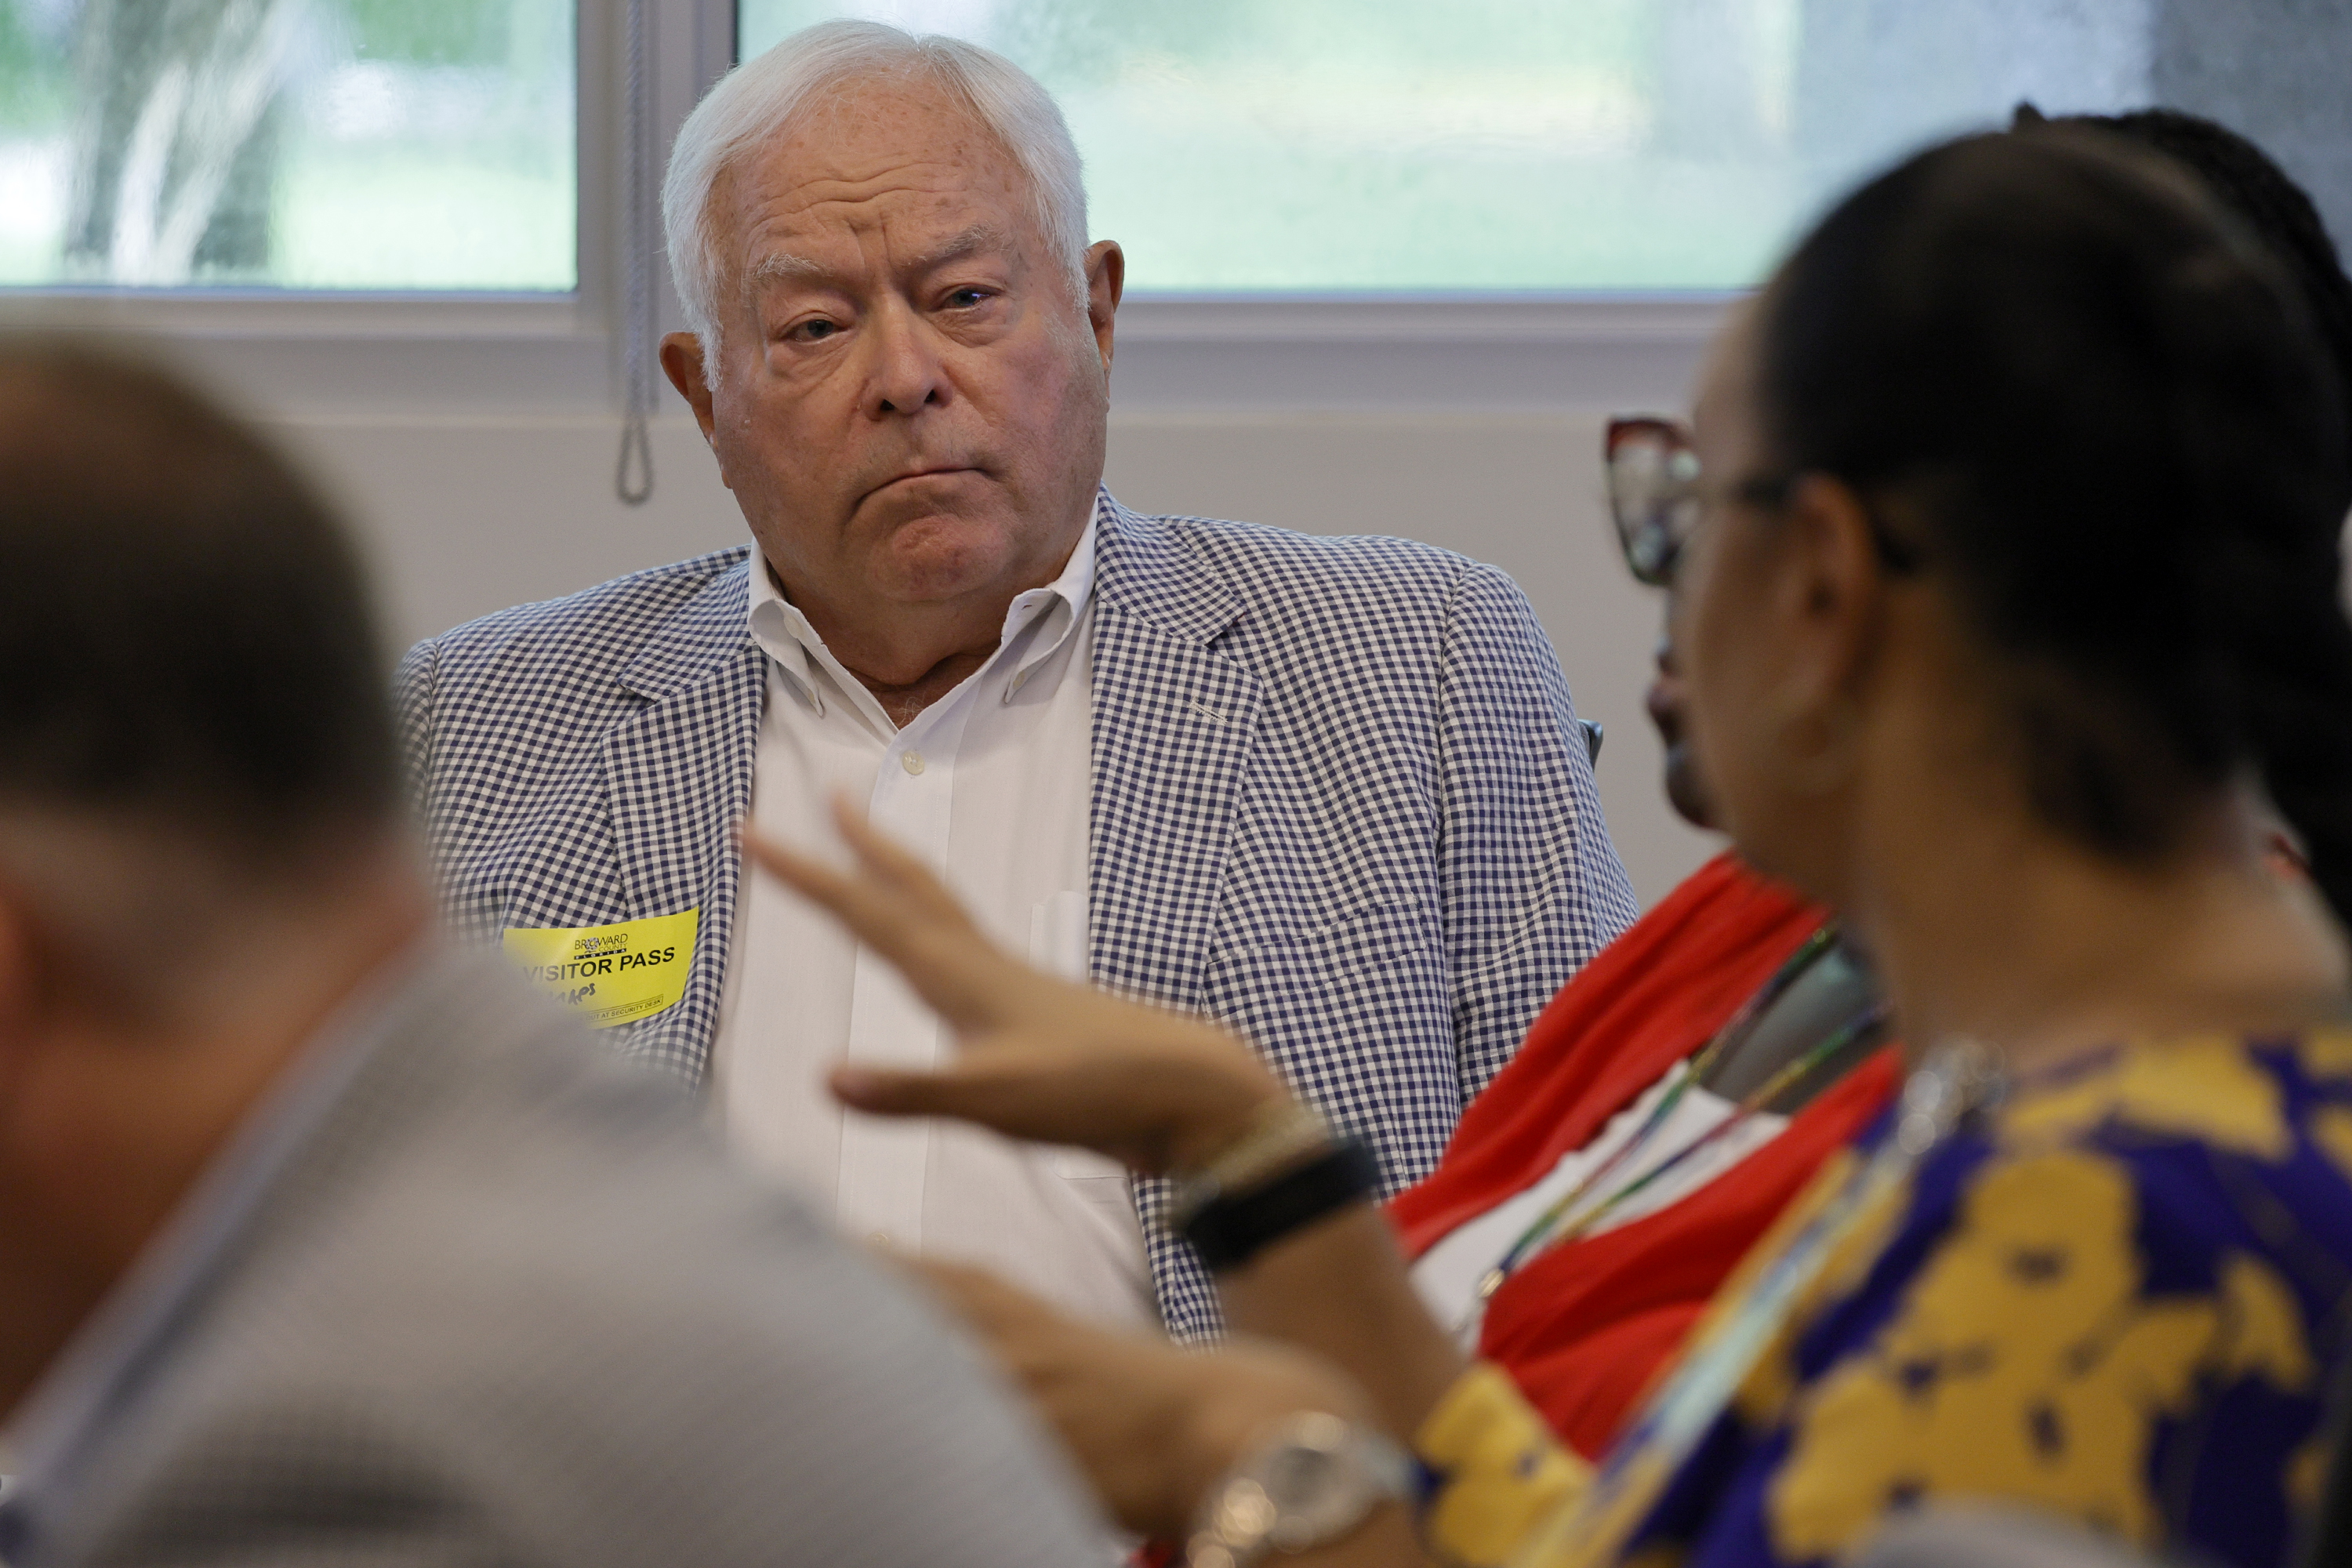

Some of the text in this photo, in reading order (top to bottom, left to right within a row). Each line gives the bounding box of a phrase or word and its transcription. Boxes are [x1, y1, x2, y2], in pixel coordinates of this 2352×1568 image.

[575, 934, 628, 950] BROWARD
[599, 943, 627, 953] COUNTY
[575, 949, 626, 960] FLORIDA
[523, 946, 675, 982] VISITOR PASS
[612, 1005, 644, 1017] SECURITY
[644, 999, 661, 1008] DESK
